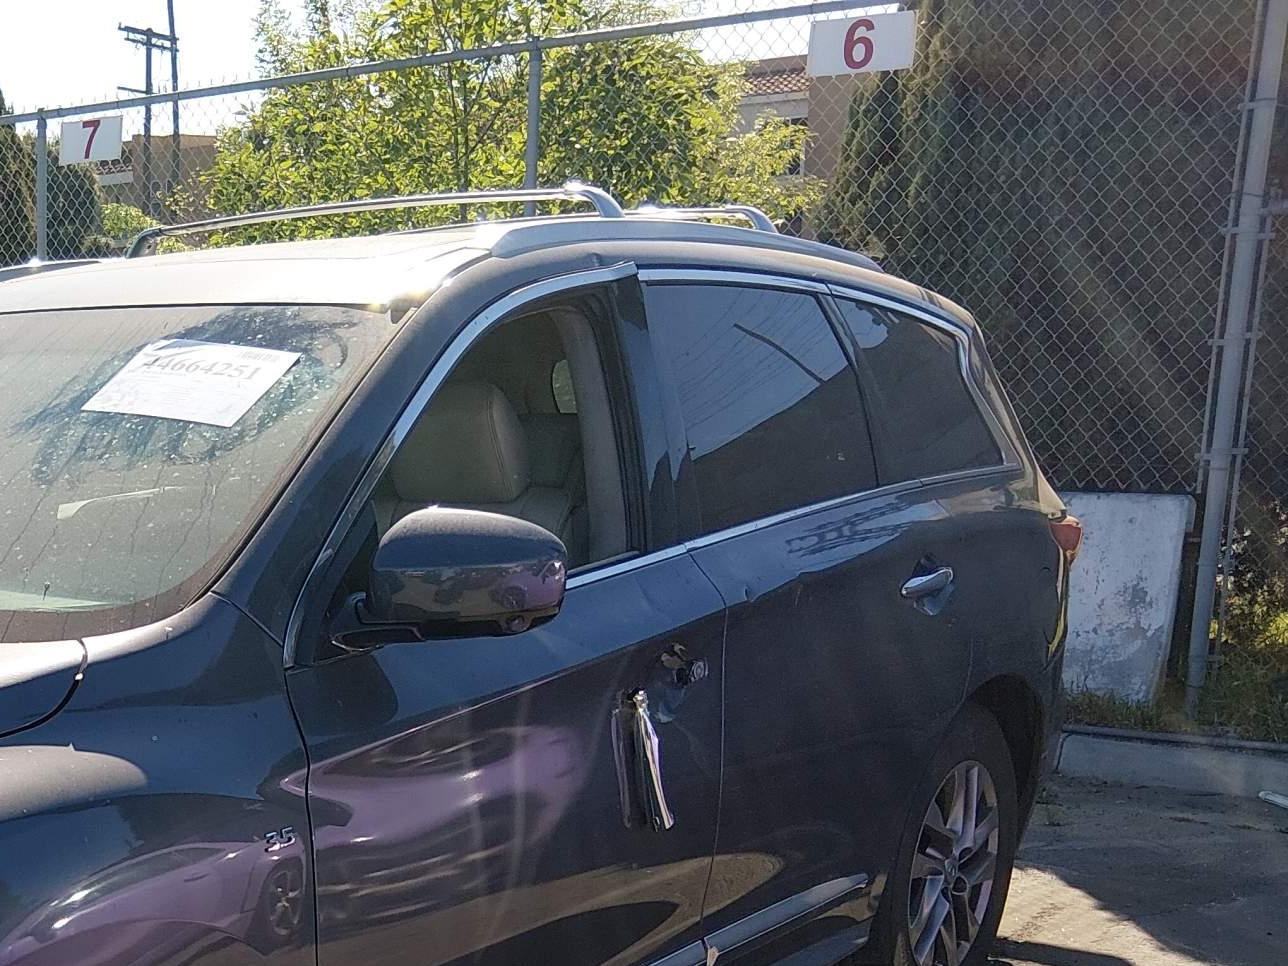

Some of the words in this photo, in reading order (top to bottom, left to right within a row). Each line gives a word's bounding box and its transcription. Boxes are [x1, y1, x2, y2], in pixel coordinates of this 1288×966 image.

[843, 18, 875, 70] 6
[82, 119, 101, 159] 7
[264, 826, 297, 853] 35
